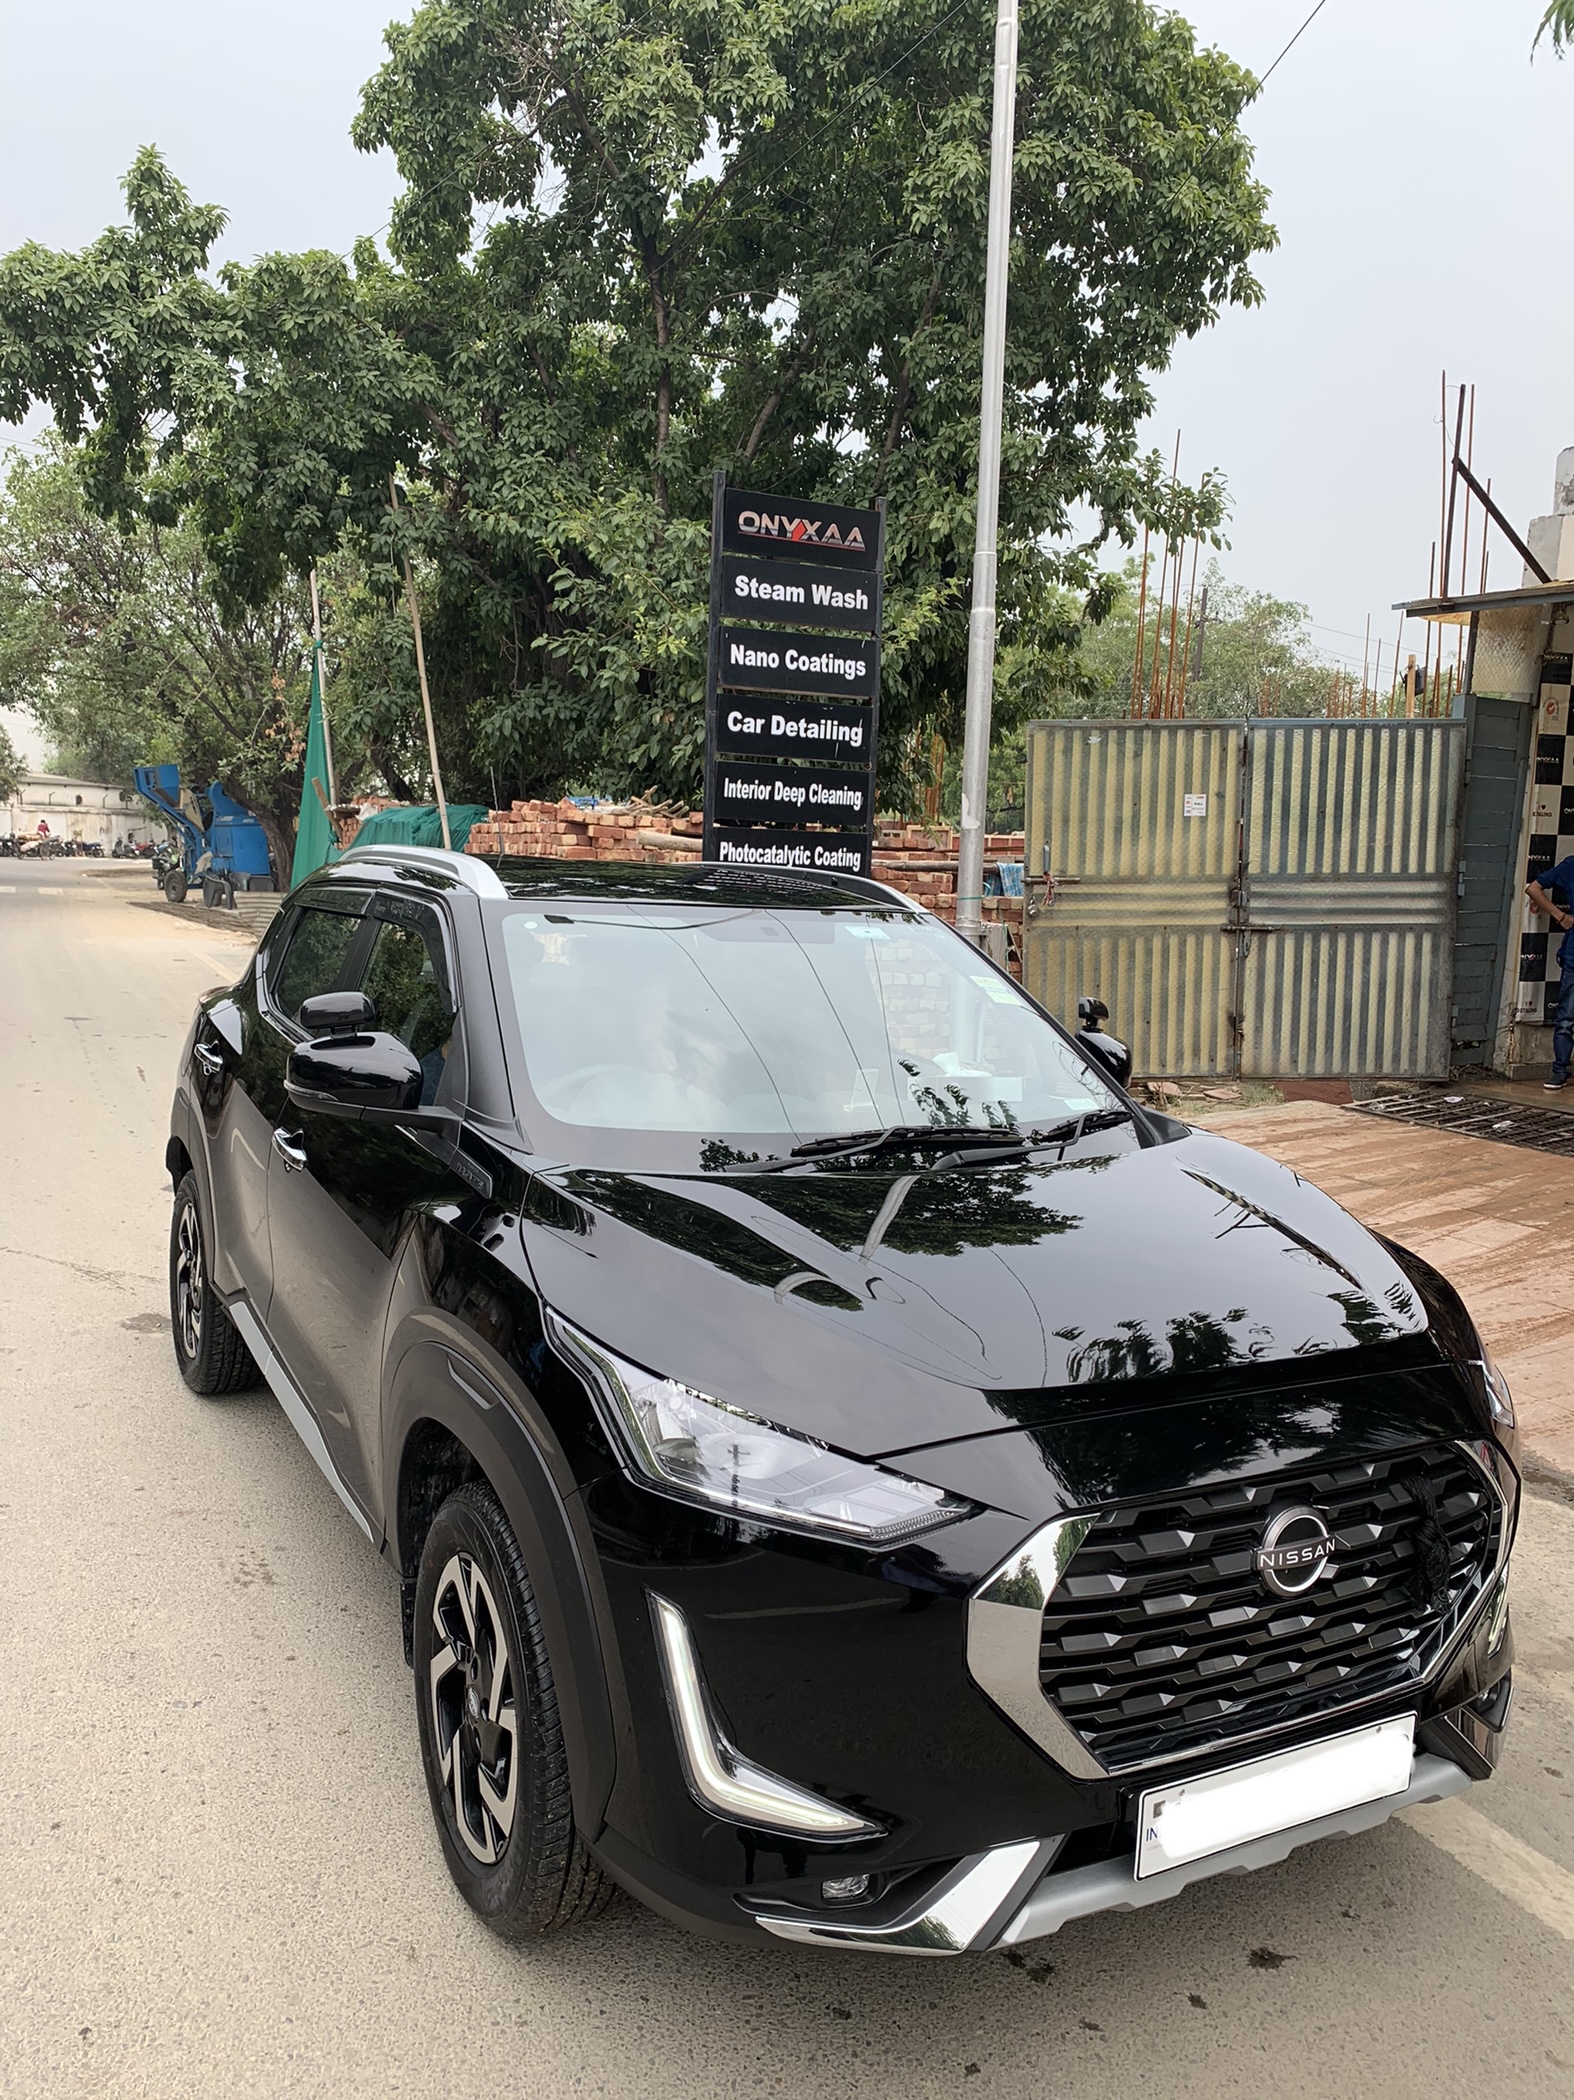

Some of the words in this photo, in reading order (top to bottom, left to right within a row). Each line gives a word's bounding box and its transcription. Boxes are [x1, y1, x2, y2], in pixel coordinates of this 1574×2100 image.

[738, 510, 866, 550] ONYXAA
[734, 575, 805, 603] Steam
[811, 583, 869, 610] Wash
[730, 644, 780, 668] Nano
[784, 648, 867, 681] Coatings
[727, 711, 766, 734] Car
[771, 715, 863, 747] Detailing
[723, 778, 771, 800] Interior
[774, 781, 806, 807] Deep
[809, 783, 862, 811] Cleaning
[719, 841, 811, 868] Photocatalytic
[814, 846, 862, 872] Coating
[1260, 1539, 1335, 1567] NISSAN
